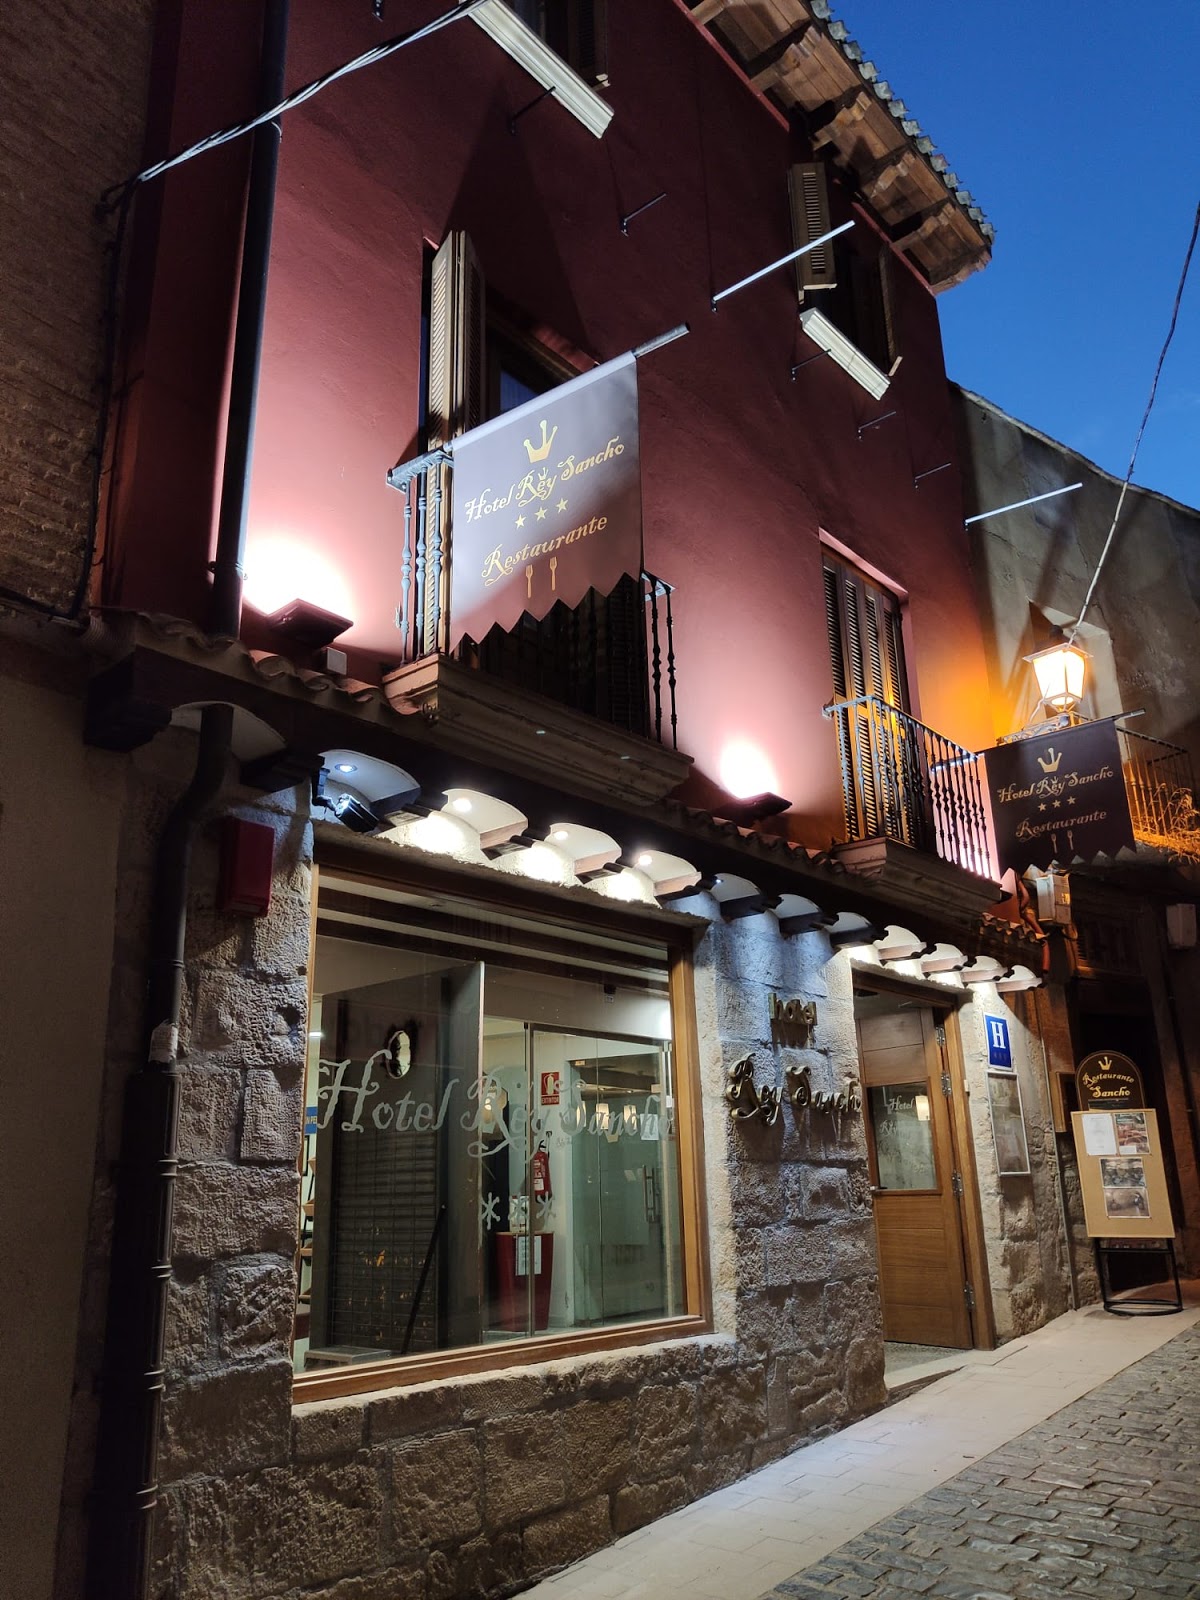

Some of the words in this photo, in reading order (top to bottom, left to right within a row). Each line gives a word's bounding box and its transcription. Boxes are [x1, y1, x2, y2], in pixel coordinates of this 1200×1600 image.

[465, 485, 515, 523] Hotel
[515, 470, 557, 507] Rey
[557, 436, 625, 481] Sancho
[482, 516, 608, 586] Restaurante
[997, 782, 1035, 803] Hotel
[1036, 777, 1065, 798] Rey
[1064, 766, 1114, 787] Sancho
[1016, 810, 1107, 842] Restaurante
[990, 1021, 1006, 1049] H
[726, 1053, 783, 1126] Rey
[1083, 1072, 1134, 1088] Restaurante
[1089, 1085, 1131, 1098] Sancho
[317, 1049, 460, 1133] Hotel
[460, 1065, 550, 1163] Rey
[554, 1079, 671, 1137] Sancho
[889, 1095, 914, 1111] Hotel
